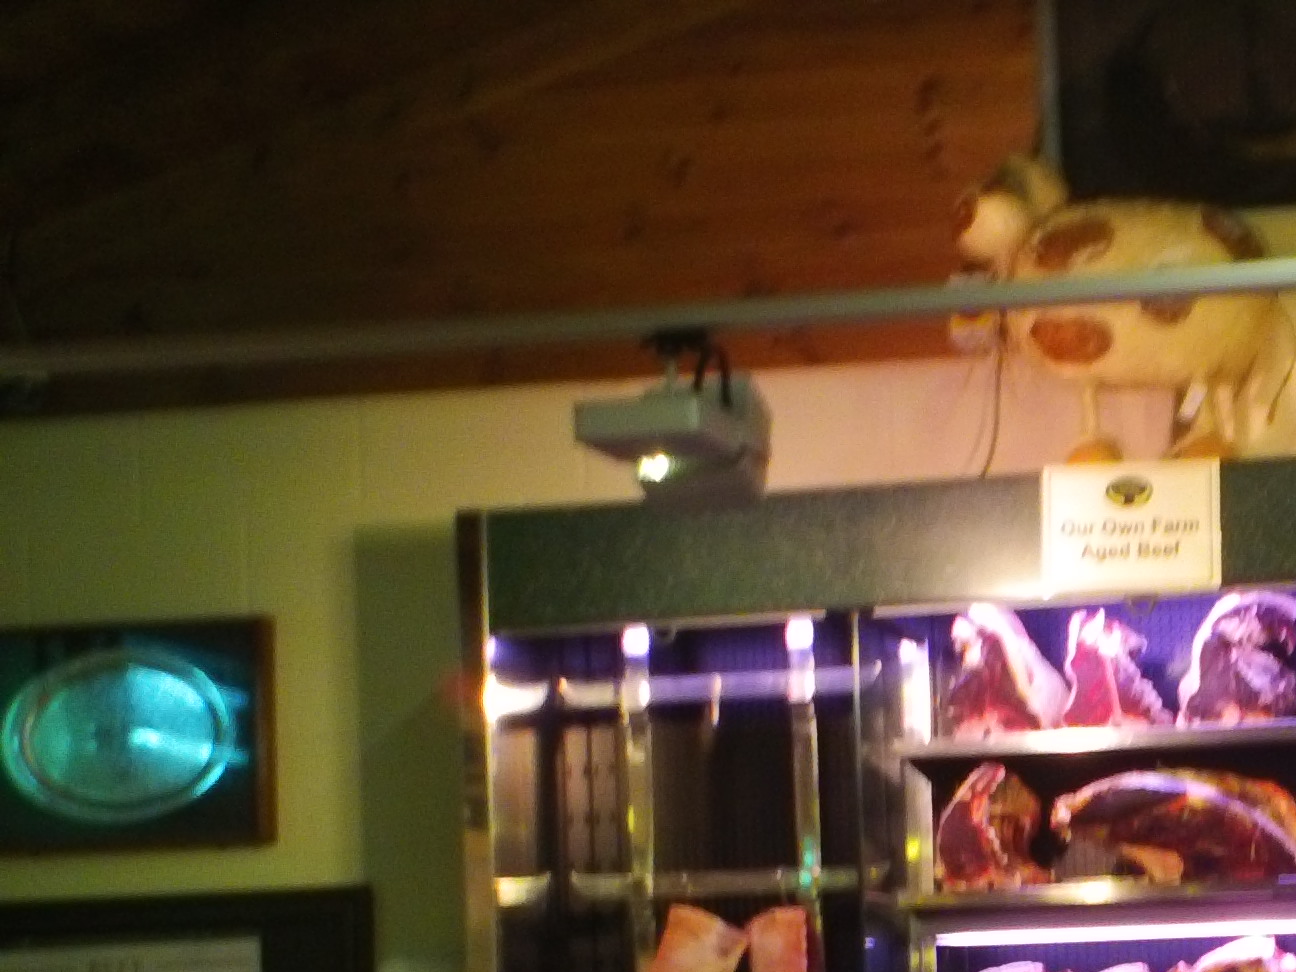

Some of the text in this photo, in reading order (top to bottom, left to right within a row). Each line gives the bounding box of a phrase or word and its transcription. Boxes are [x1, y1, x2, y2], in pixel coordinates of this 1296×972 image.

[1060, 515, 1200, 537] Our Own Farm
[1081, 540, 1181, 562] Aged Beef
